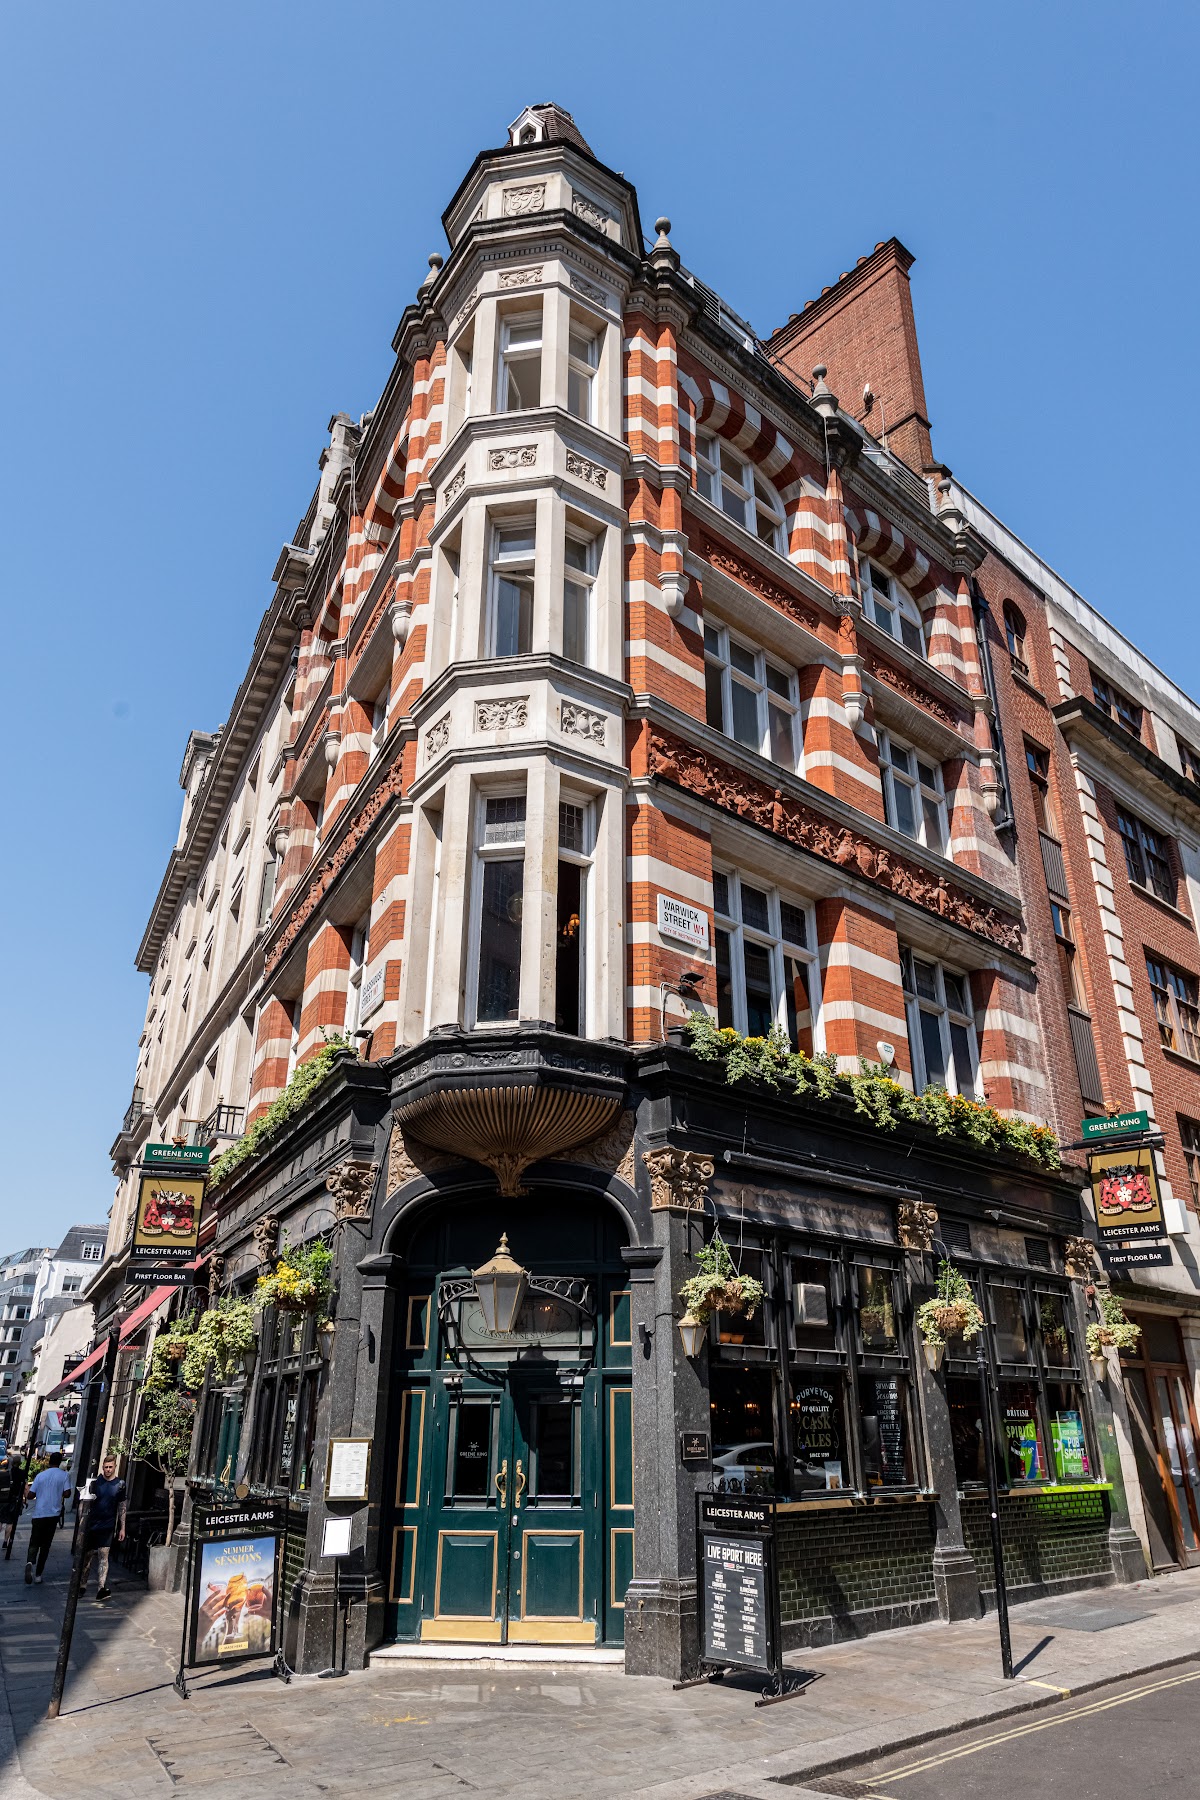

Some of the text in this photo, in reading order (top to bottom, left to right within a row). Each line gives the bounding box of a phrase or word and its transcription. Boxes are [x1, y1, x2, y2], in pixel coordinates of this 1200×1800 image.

[663, 900, 699, 922] WARWICK
[663, 911, 704, 936] STREET W1
[1088, 1122, 1118, 1132] GREENE
[1120, 1117, 1141, 1127] KING
[151, 1149, 182, 1158] GREENE
[183, 1151, 204, 1159] KING
[1102, 1224, 1160, 1237] LEICESTER ARMS
[135, 1247, 192, 1256] LEICESTER ARMS
[1127, 1254, 1149, 1262] FLOOR
[1148, 1252, 1163, 1260] BAR
[134, 1272, 152, 1280] FIRST
[796, 1387, 834, 1404] PURVEYOR
[809, 1405, 830, 1414] QUALITY
[1006, 1409, 1030, 1417] BRITISH
[802, 1415, 832, 1430] CASK
[1005, 1425, 1035, 1439] SPIRITS
[804, 1433, 832, 1448] ALES
[1067, 1436, 1080, 1448] PUB
[1064, 1448, 1086, 1460] SPORT
[205, 1511, 274, 1526] LEICESTER ARMS
[706, 1507, 765, 1521] LEICESTER ARMS
[223, 1544, 255, 1555] SUMMER
[707, 1545, 762, 1566] LIVE SPORT HERE
[214, 1551, 262, 1567] SESSIONS
